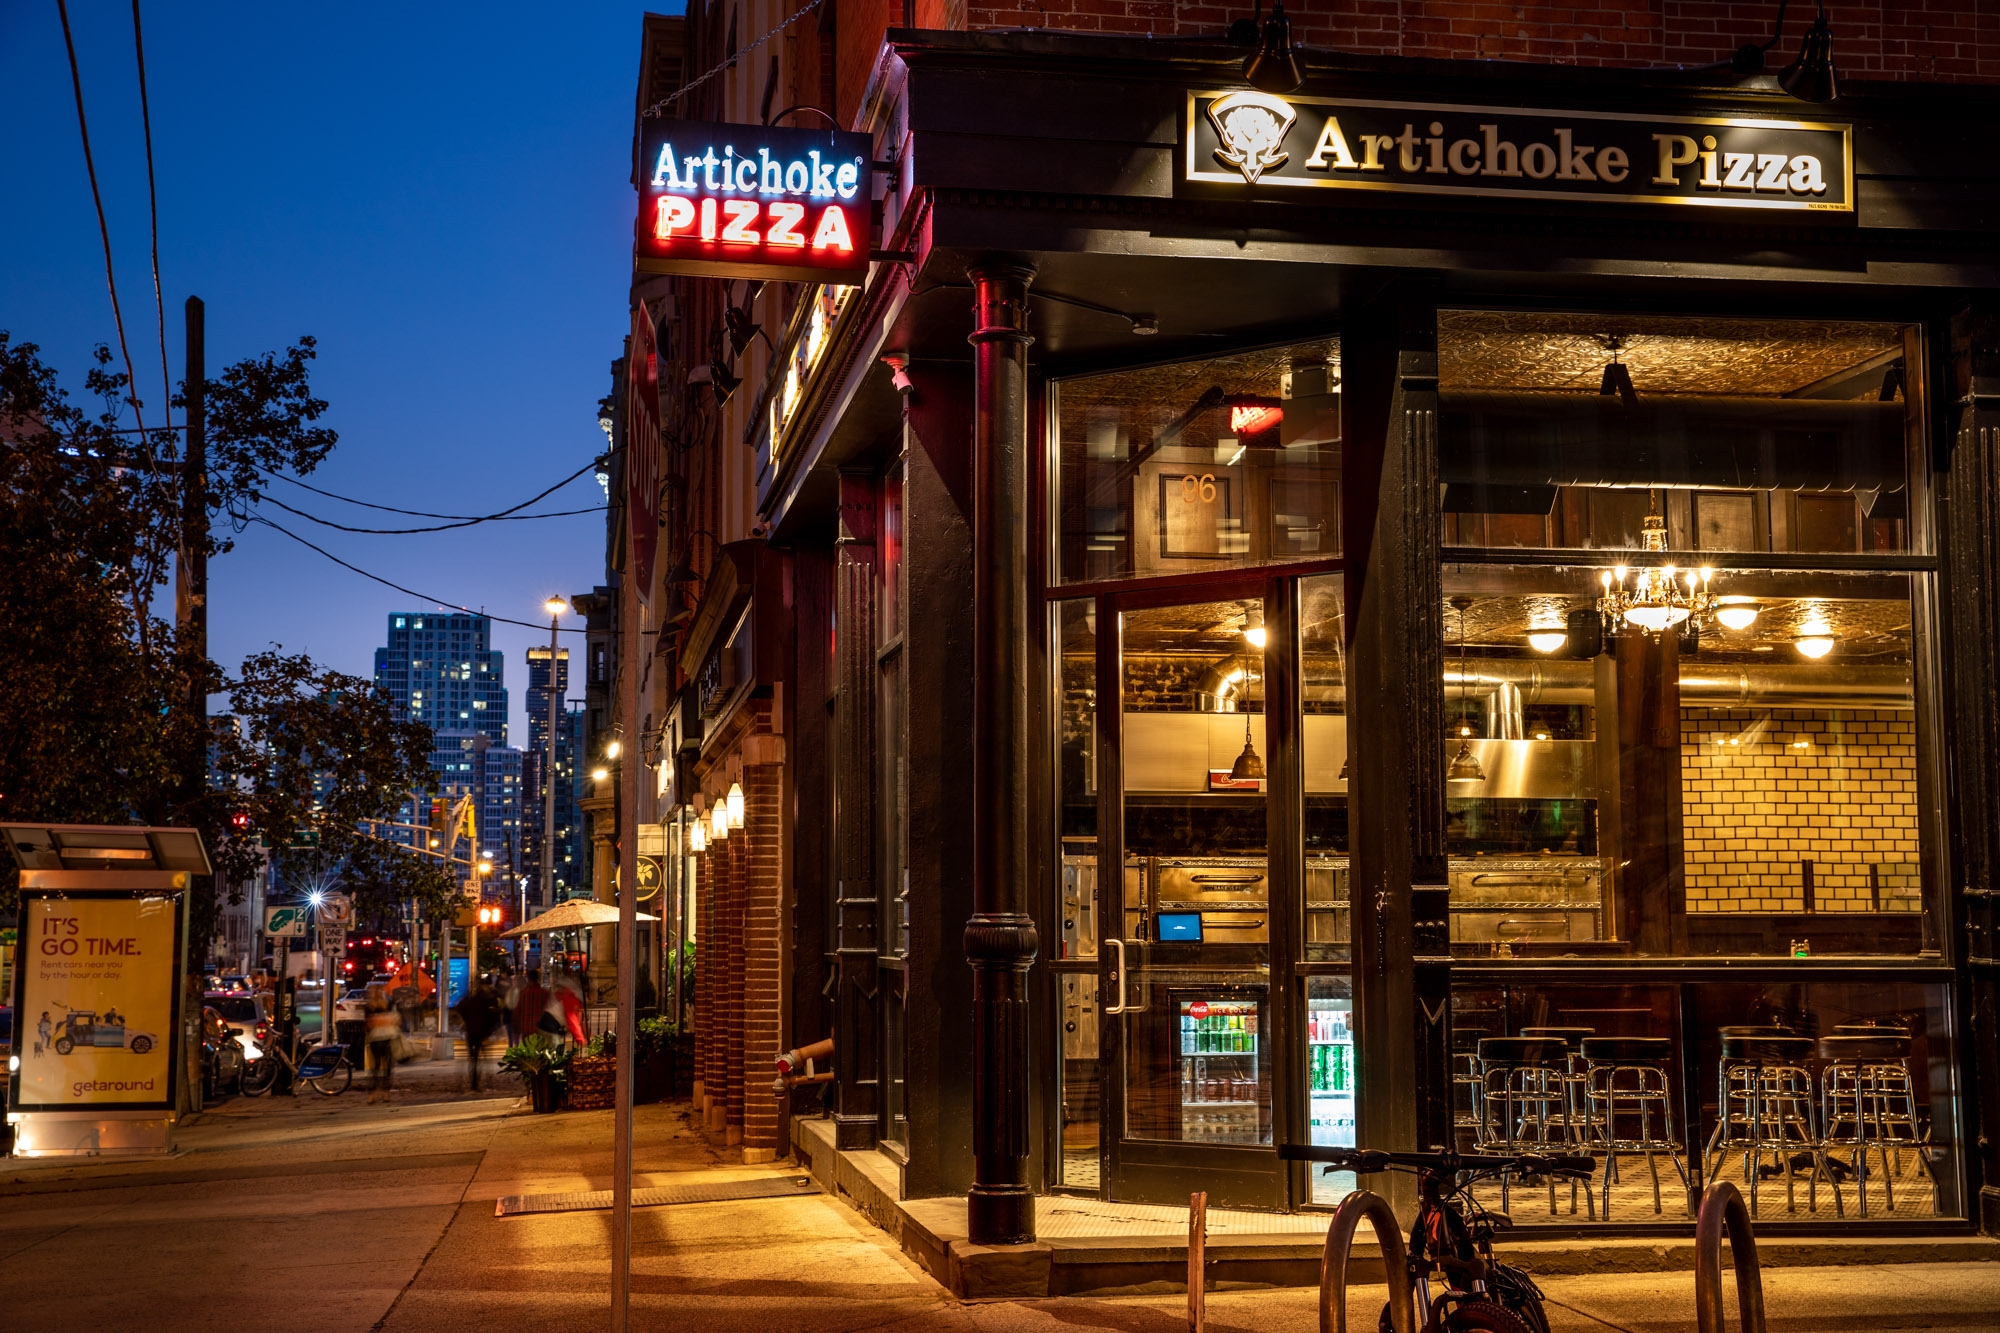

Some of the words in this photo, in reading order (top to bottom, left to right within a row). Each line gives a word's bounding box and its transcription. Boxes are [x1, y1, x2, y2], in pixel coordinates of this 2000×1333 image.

[1305, 116, 1629, 183] Artichoke
[1652, 133, 1827, 194] Pizza
[651, 143, 858, 198] Artichoke
[656, 195, 853, 250] PIZZA
[630, 384, 659, 516] STOP
[1182, 473, 1217, 503] 96
[298, 907, 304, 919] 2
[43, 918, 79, 935] IT'S
[325, 928, 343, 936] ONE
[41, 938, 79, 956] GO
[85, 938, 142, 956] TIME.
[40, 960, 62, 969] Rent
[63, 961, 82, 969] cars
[84, 961, 105, 969] near
[106, 962, 123, 972] you
[40, 971, 51, 980] by
[52, 970, 68, 979] the
[70, 970, 90, 979] hour
[103, 970, 122, 980] day.
[73, 1077, 154, 1097] getaround
